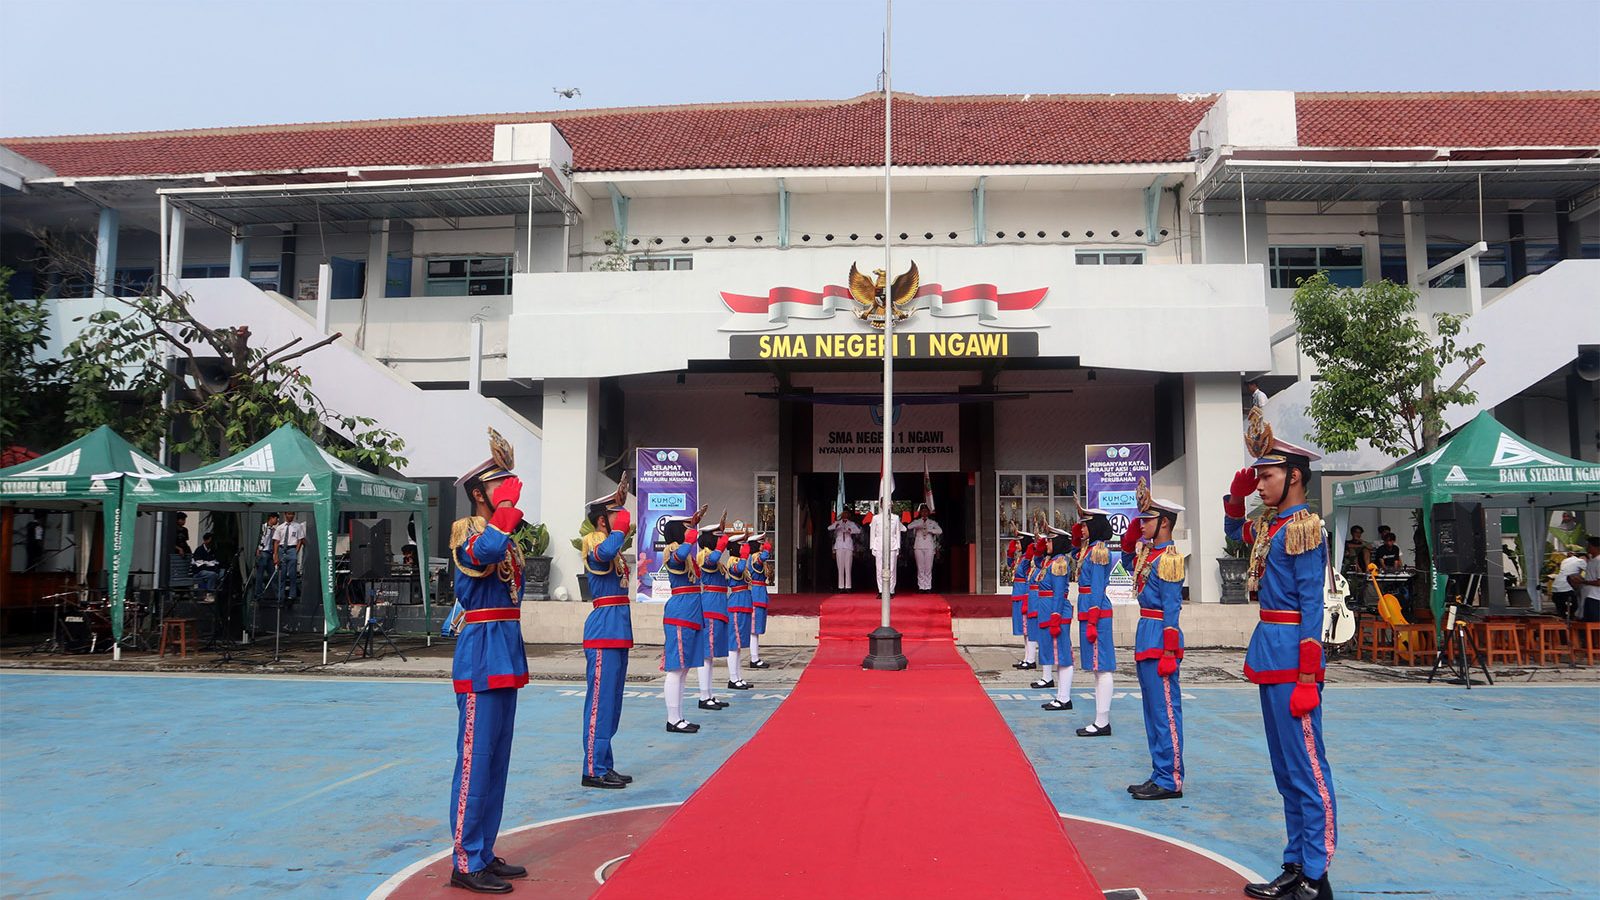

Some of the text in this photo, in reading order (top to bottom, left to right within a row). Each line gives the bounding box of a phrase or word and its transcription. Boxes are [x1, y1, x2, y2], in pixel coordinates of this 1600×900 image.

[759, 335, 808, 358] SMA
[907, 334, 916, 356] 1
[929, 333, 1008, 356] NGAWI
[828, 430, 944, 444] SMA NEGEI 1 NGAWI
[1499, 468, 1528, 483] BANK
[1529, 468, 1574, 483] SYARIAH
[2, 480, 67, 494] SYARIAH NGAWI
[178, 480, 272, 493] BANK SYARIAH NGAWI
[360, 482, 406, 500] BANK SYARIAH NGAWI
[1353, 474, 1400, 494] BANK SYARIAH NGAWI
[651, 496, 682, 504] KUMON
[1102, 494, 1134, 502] KUMON
[1111, 515, 1128, 534] BA
